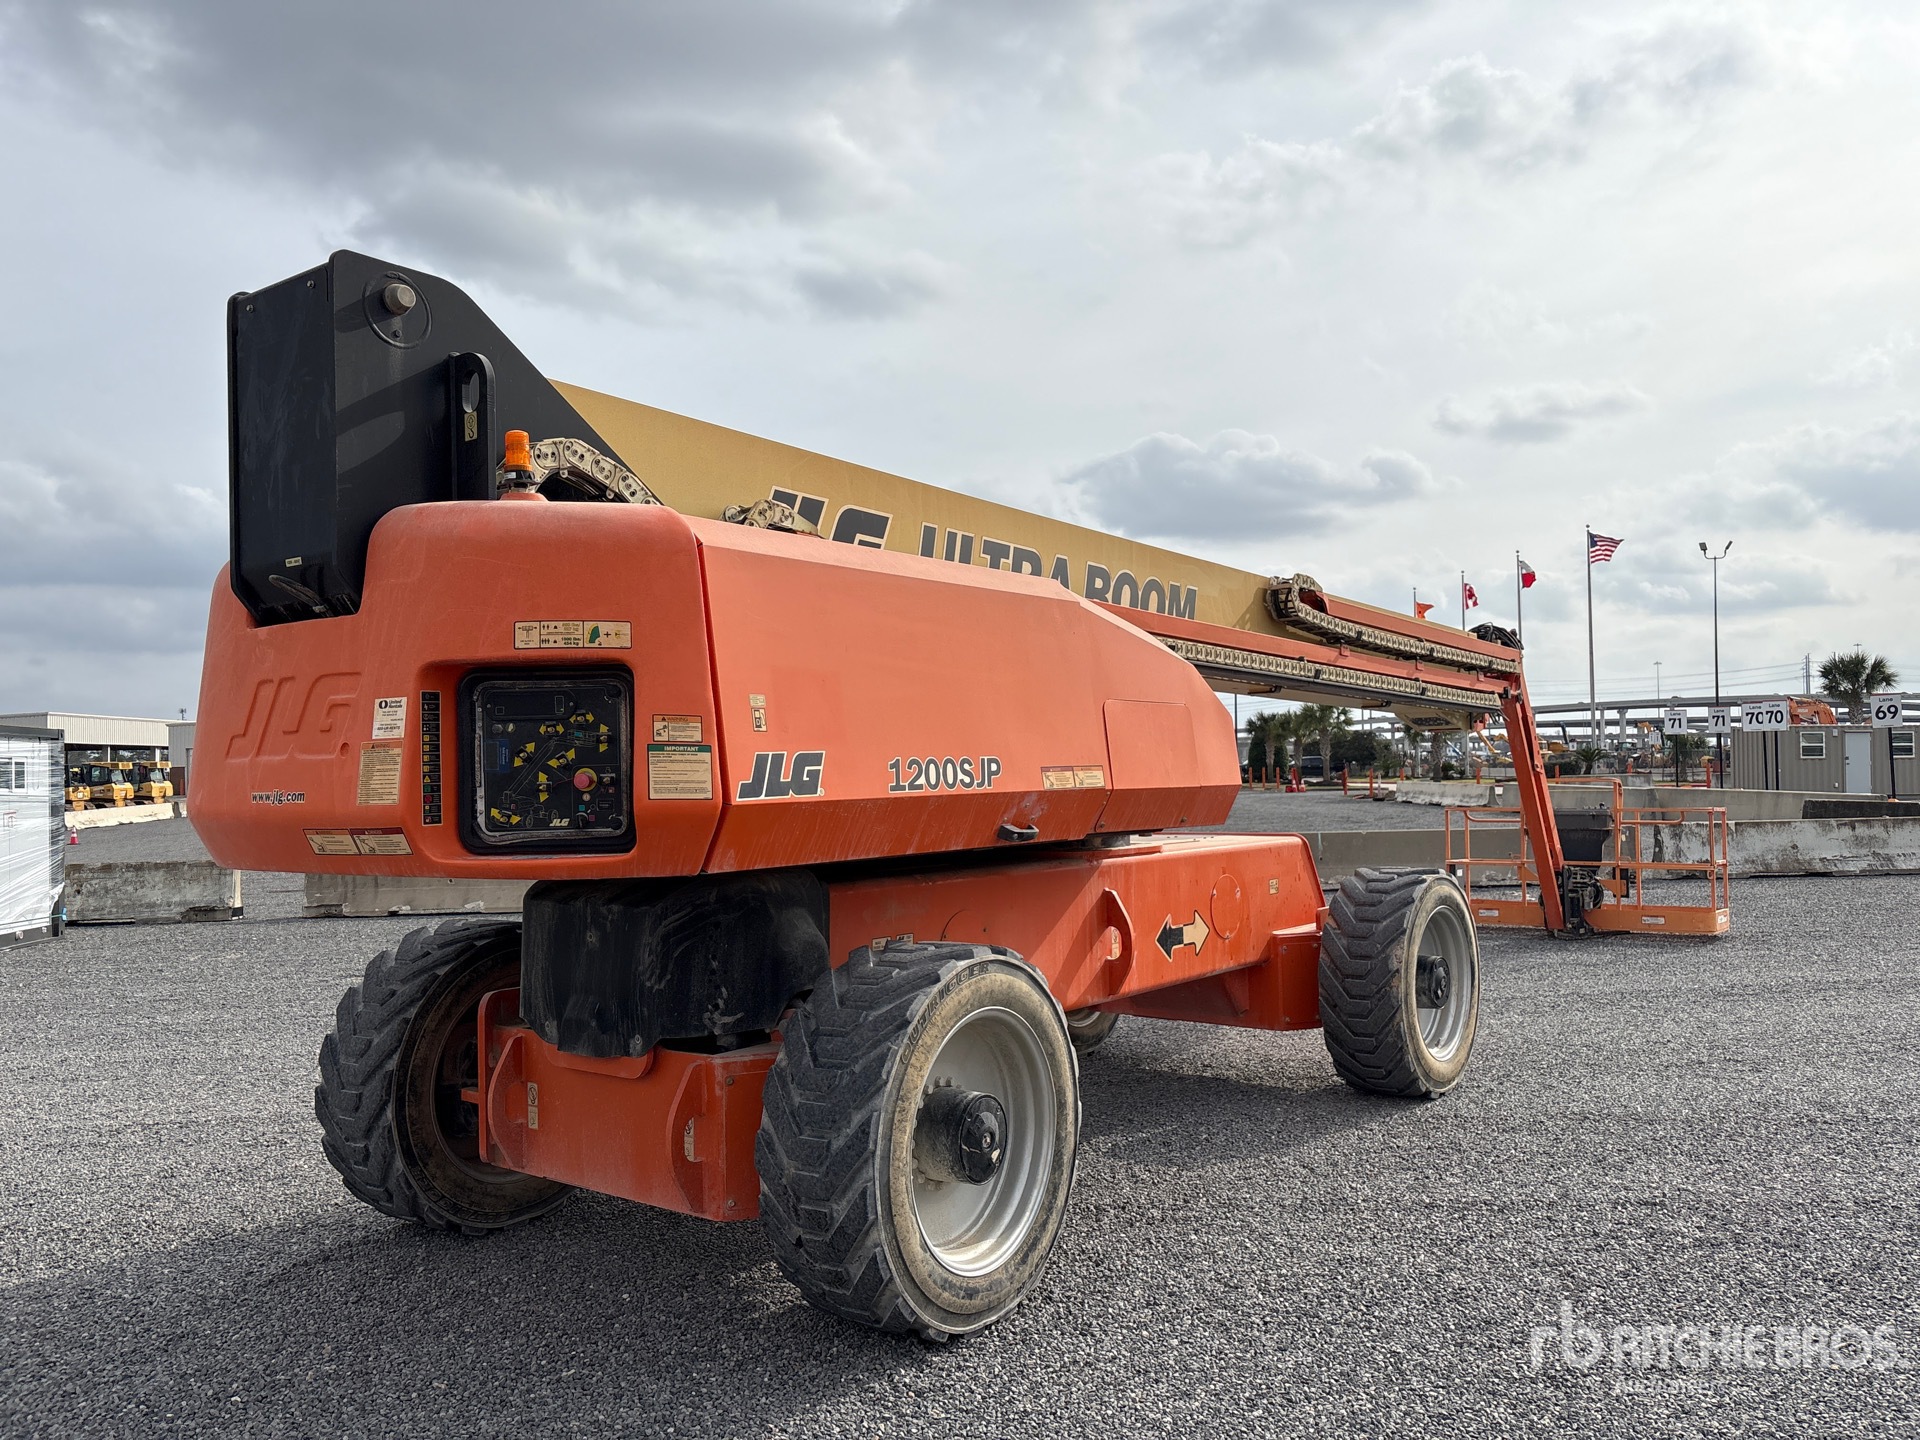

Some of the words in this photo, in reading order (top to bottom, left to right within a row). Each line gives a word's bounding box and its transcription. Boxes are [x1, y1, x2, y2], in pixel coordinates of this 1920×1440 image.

[1084, 561, 1198, 620] BOOM
[225, 672, 361, 762] JLG
[1765, 710, 1784, 724] 70
[1875, 704, 1899, 720] 69
[1668, 718, 1682, 729] 71
[1712, 715, 1726, 727] 71
[737, 751, 825, 800] JLG
[888, 757, 1002, 793] 1200SJP
[251, 789, 305, 806] www.jlg.com
[549, 818, 570, 827] JLG
[901, 962, 990, 1064] OUTRIGGER
